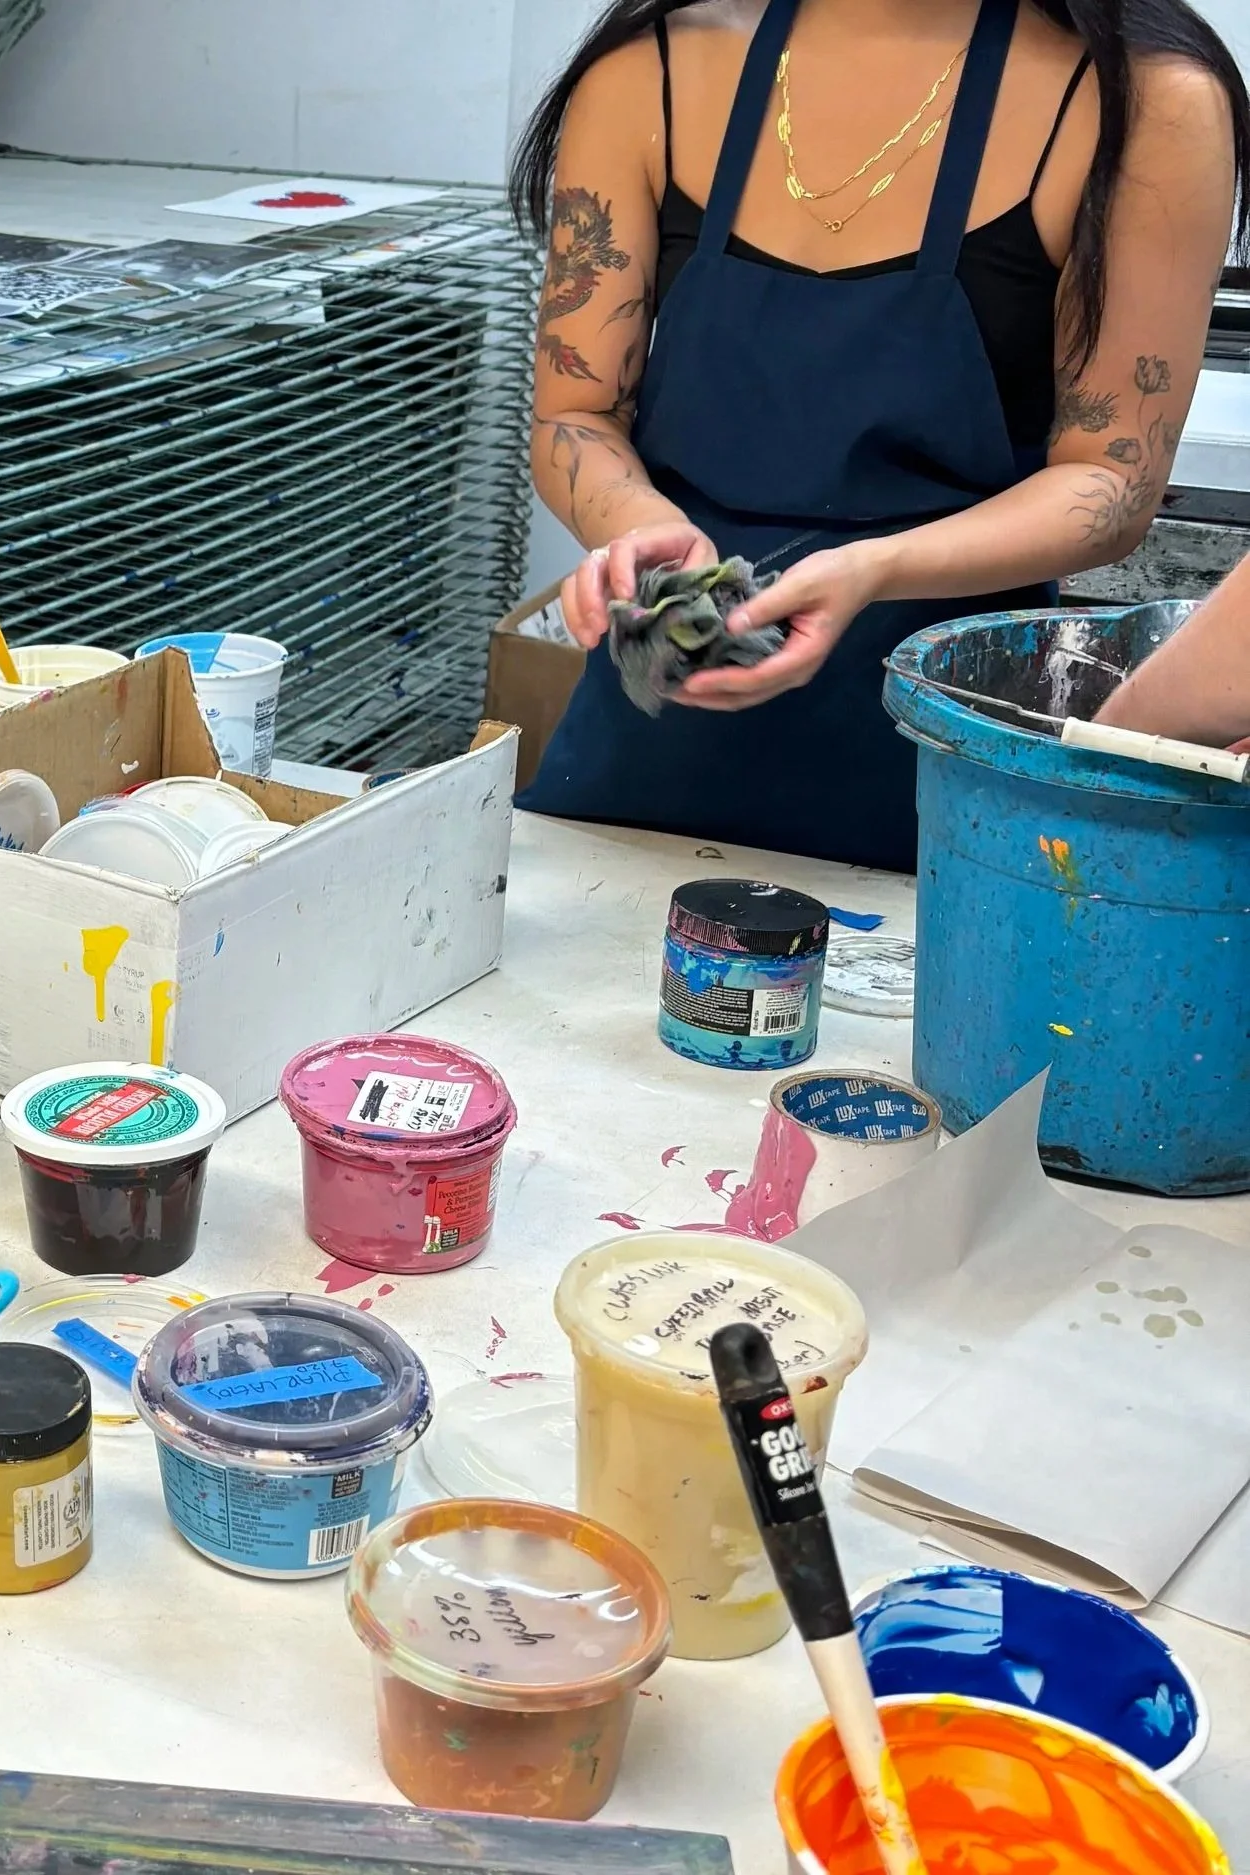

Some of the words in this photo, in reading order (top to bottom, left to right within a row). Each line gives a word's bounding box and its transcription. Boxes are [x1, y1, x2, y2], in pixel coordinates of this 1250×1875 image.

[844, 1080, 867, 1097] LUX
[808, 1089, 828, 1109] LUX
[824, 1088, 841, 1098] TAPE
[835, 1104, 857, 1123] LUX
[854, 1106, 870, 1115] TAPE
[874, 1099, 895, 1116] LUX
[892, 1103, 906, 1112] TAPE
[865, 1125, 887, 1140] LUX
[883, 1128, 897, 1137] TAPE
